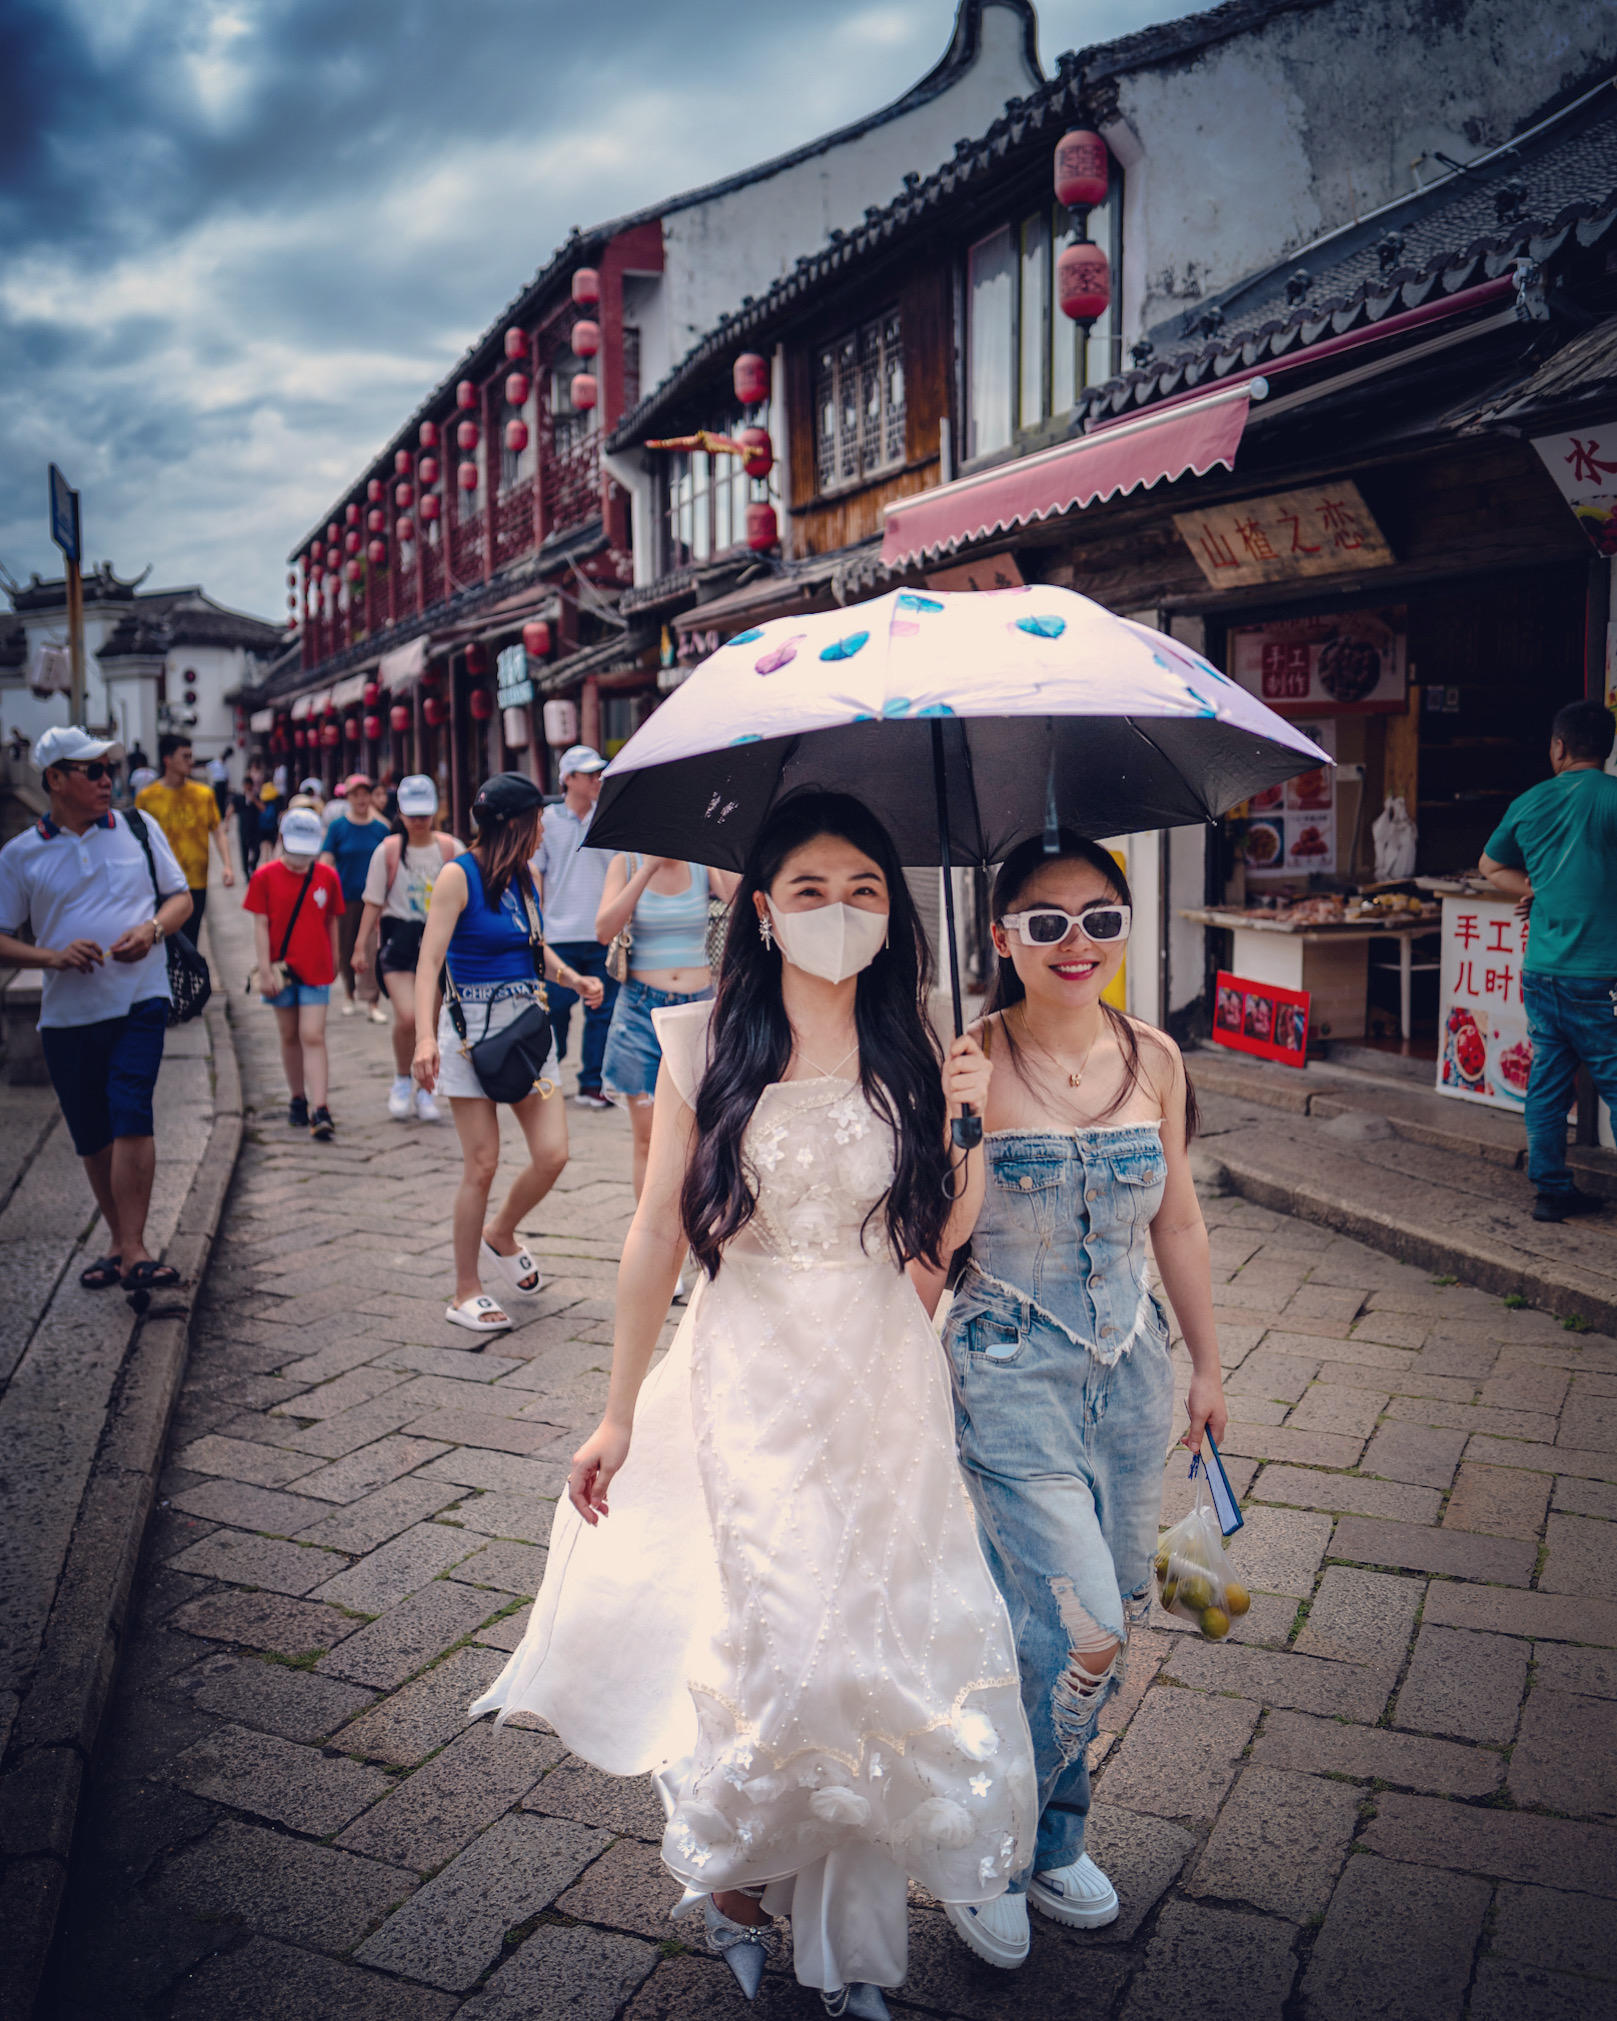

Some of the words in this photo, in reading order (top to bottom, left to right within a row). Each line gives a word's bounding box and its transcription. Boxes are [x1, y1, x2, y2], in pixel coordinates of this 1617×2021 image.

[1200, 498, 1364, 568] 山楂之恋
[1266, 645, 1307, 671] 手工
[1454, 961, 1524, 1003] 儿时
